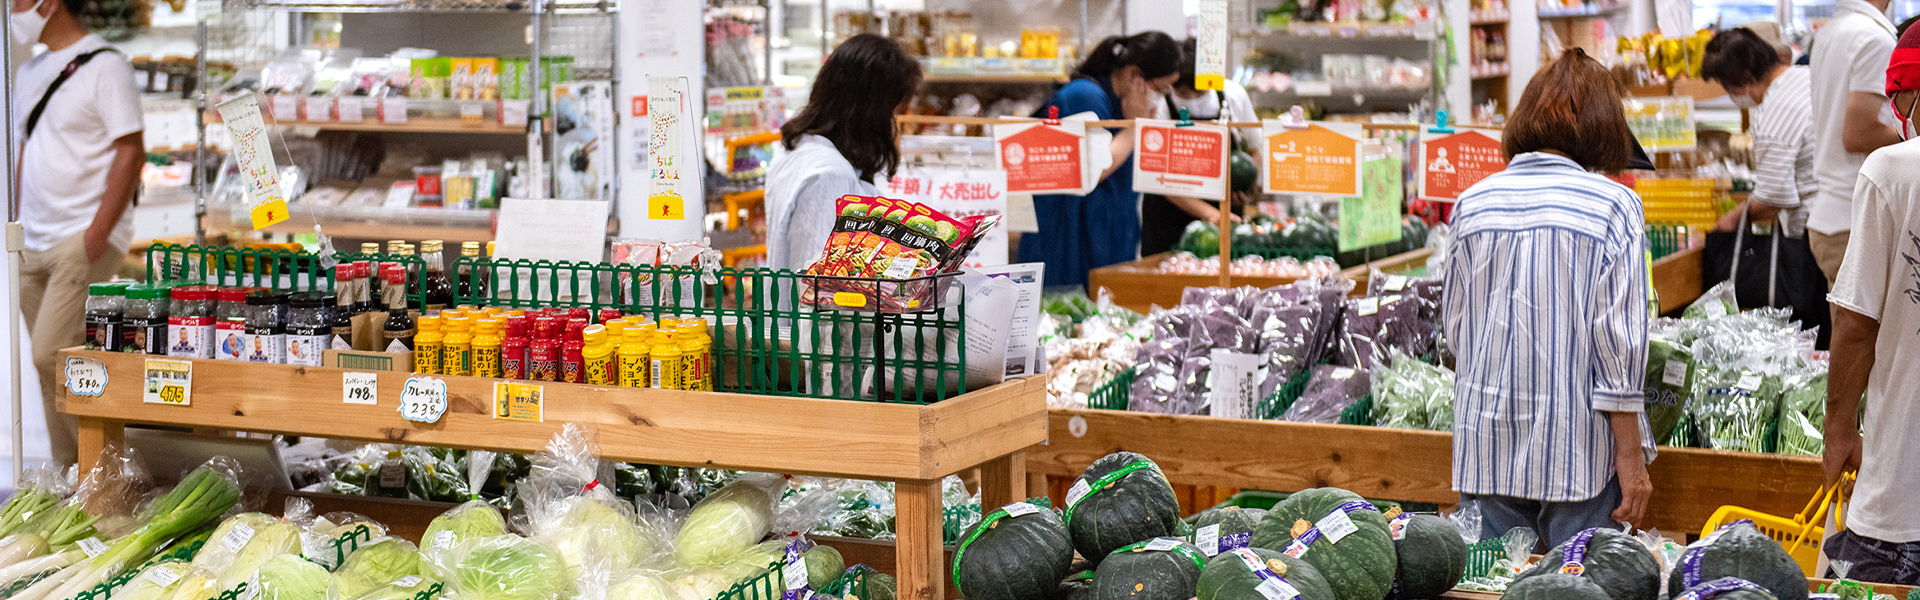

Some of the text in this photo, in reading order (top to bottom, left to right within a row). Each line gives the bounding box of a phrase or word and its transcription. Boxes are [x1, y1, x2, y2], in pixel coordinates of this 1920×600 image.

[657, 154, 674, 167] ちば
[251, 163, 267, 179] ちば
[651, 168, 680, 180] まるしぇ
[249, 176, 277, 193] まるしぇ
[940, 182, 1000, 200] 大売出し
[901, 232, 940, 253] 回鍋肉
[424, 345, 432, 365] カレー
[160, 385, 185, 403] 475
